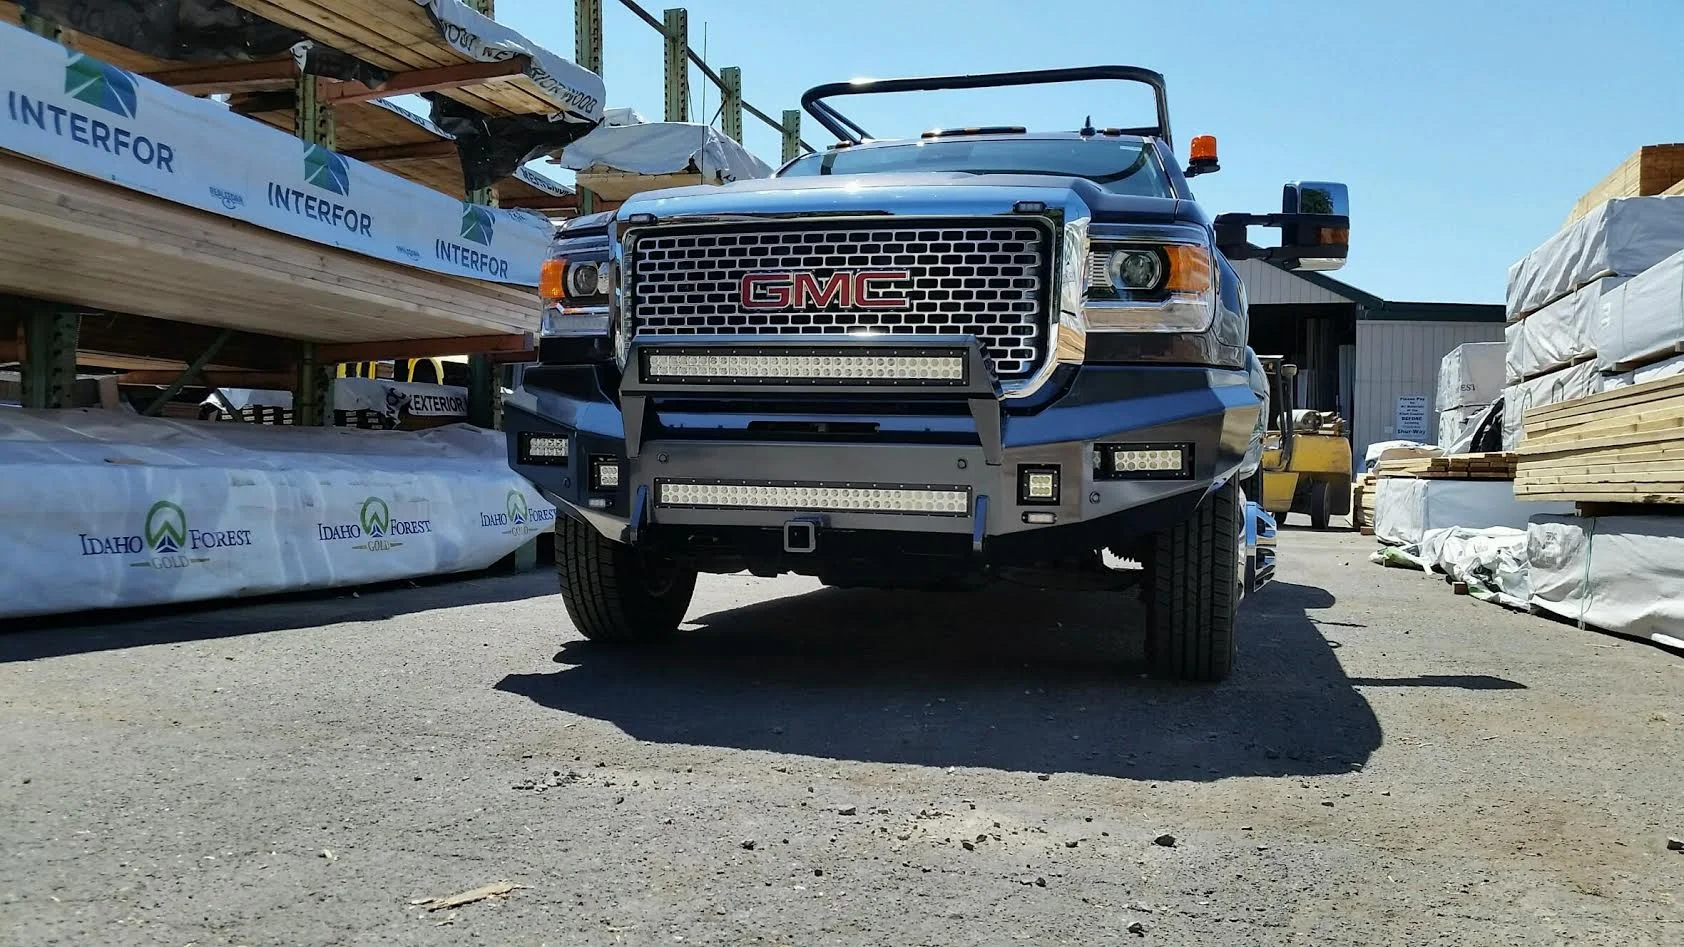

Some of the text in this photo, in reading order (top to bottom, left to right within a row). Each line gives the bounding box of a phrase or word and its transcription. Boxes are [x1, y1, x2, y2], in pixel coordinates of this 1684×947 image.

[8, 90, 174, 174] INTERFOR
[268, 181, 373, 238] INTERFOR
[435, 238, 508, 280] INTERFOR
[741, 270, 911, 309] GMC
[317, 518, 432, 541] IDAHO FOREST
[480, 512, 508, 527] IDAHO
[79, 528, 252, 556] IDAHO FOREST
[367, 540, 391, 552] GOLD
[151, 555, 191, 570] GOLD
